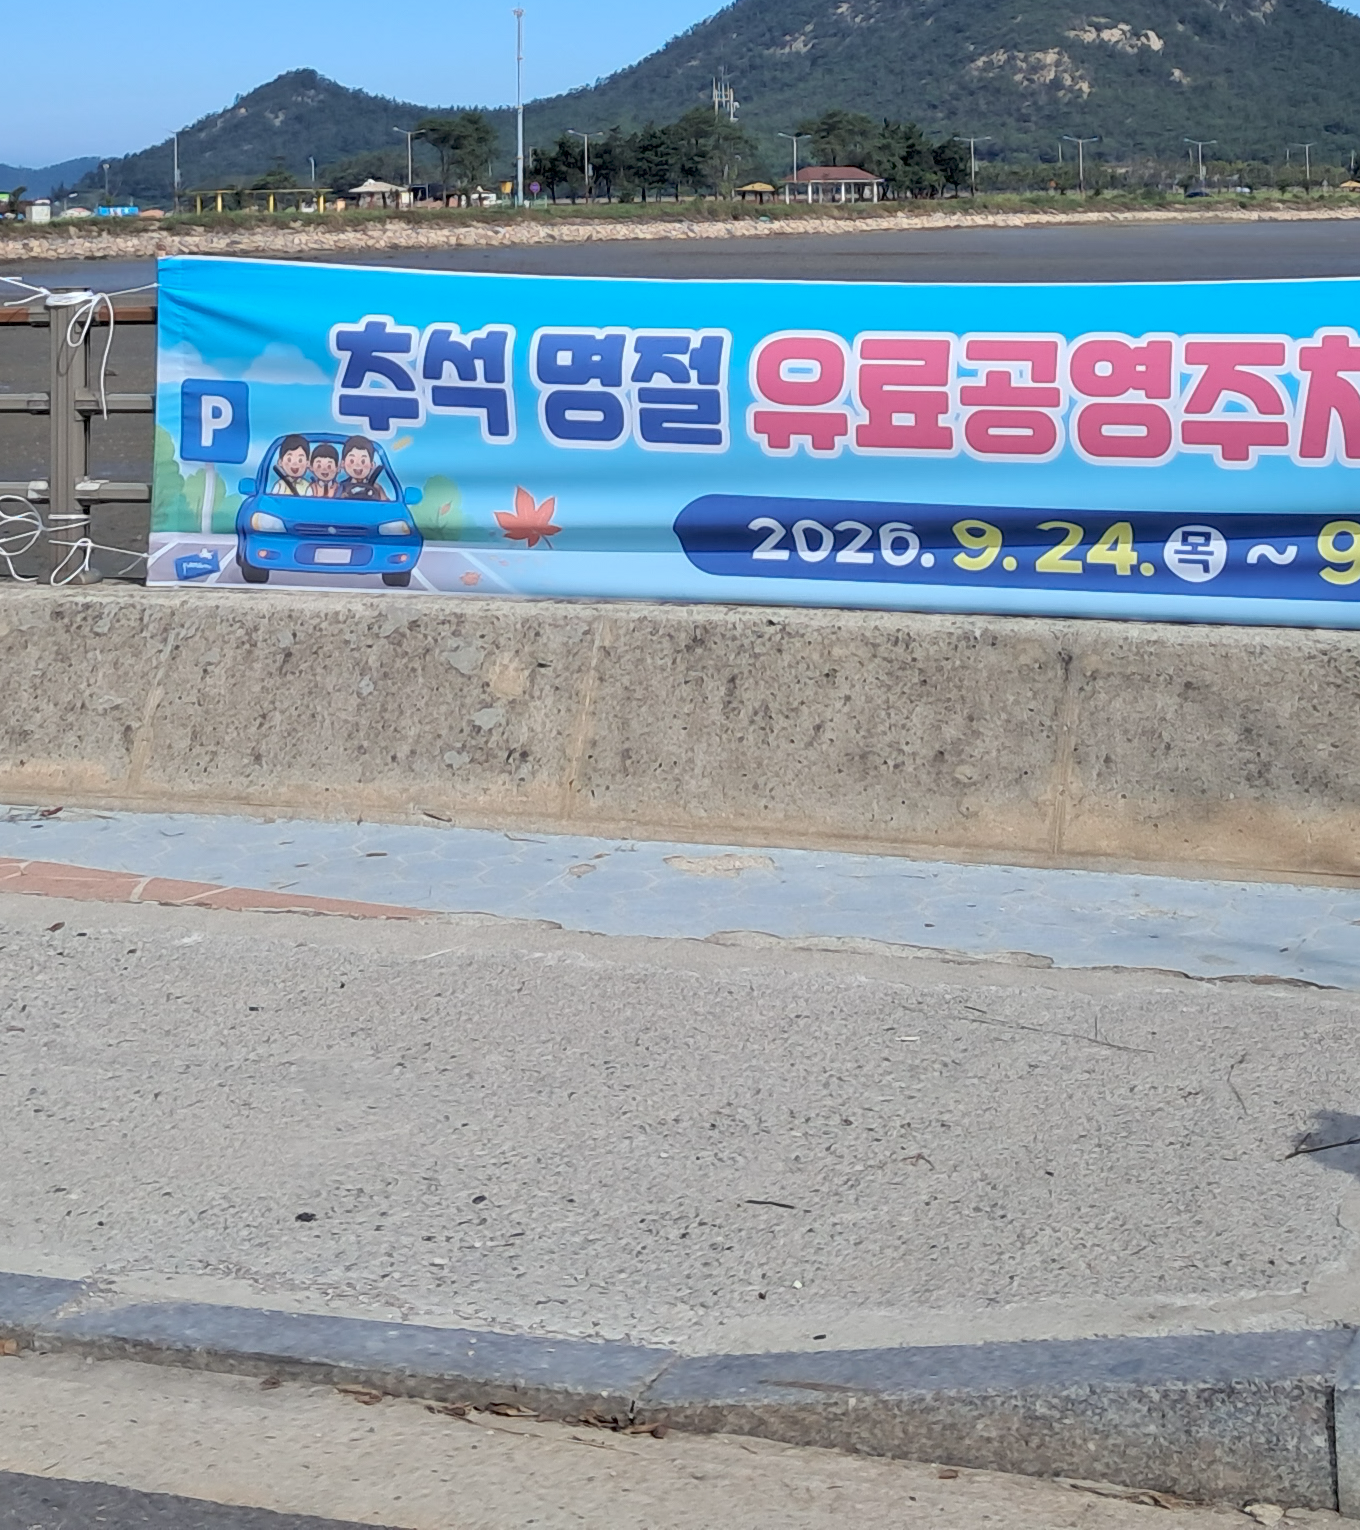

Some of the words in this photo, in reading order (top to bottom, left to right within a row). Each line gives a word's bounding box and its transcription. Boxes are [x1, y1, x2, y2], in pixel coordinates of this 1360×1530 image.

[199, 395, 233, 448] P
[334, 320, 510, 438] 추석
[538, 332, 724, 446] 명절
